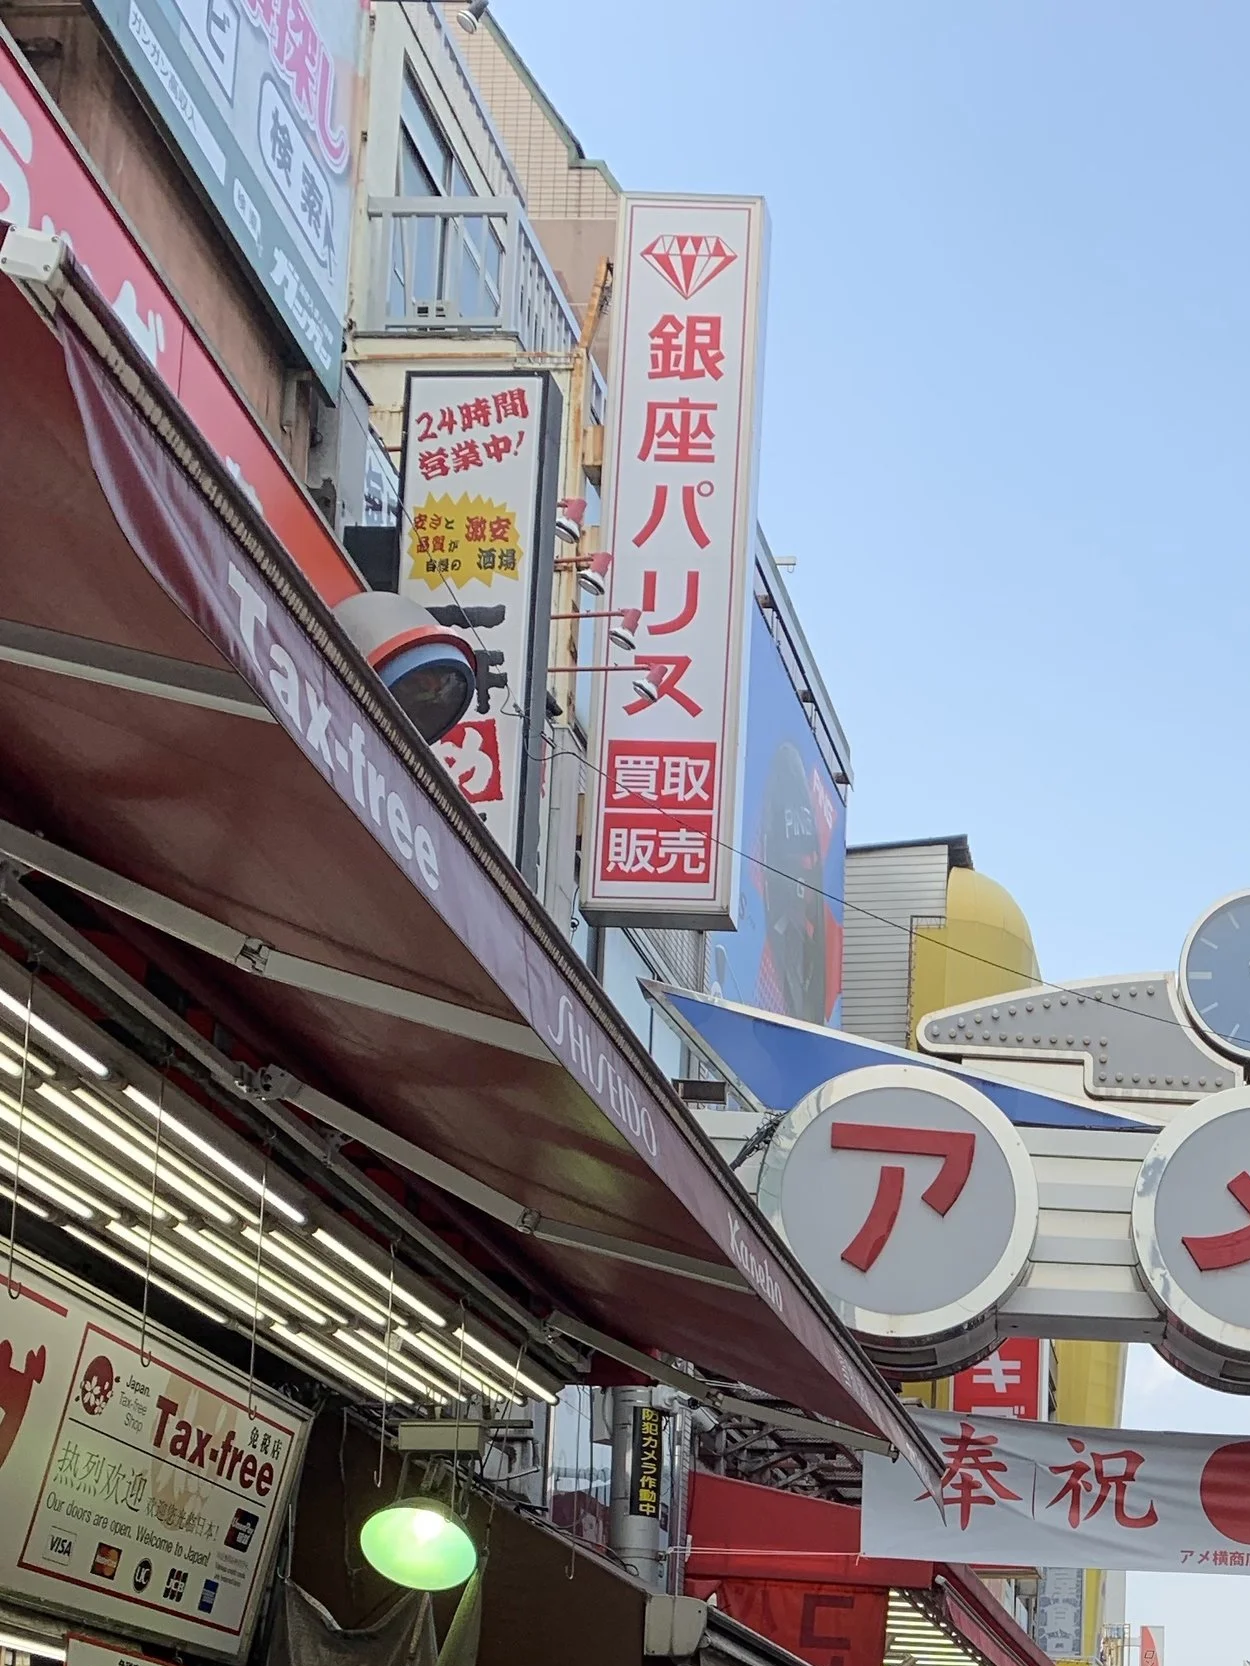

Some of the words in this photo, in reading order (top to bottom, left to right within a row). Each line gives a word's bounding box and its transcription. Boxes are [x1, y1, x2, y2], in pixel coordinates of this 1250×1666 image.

[270, 105, 325, 239] 検索
[415, 388, 530, 442] 24時間
[412, 513, 455, 530] 安さと
[465, 515, 512, 543] 激安
[622, 313, 726, 718] 銀座パリス
[415, 535, 459, 554] 品質が
[477, 547, 516, 571] 酒場
[222, 558, 441, 894] Tax-free
[611, 755, 711, 802] 買取
[605, 827, 707, 875] 販売
[547, 994, 660, 1158] SHISEIDO
[727, 1210, 785, 1314] Kanebo
[118, 1390, 148, 1417] Tax-free
[123, 1411, 144, 1434] Shop
[152, 1394, 275, 1498] Tax-free
[247, 1426, 283, 1460] 免税店
[638, 1407, 659, 1515] 防犯カメラ作動中
[52, 1440, 149, 1513] 热烈欢迎
[914, 1421, 1159, 1532] 奉祝
[46, 1491, 66, 1514] Our
[66, 1500, 92, 1524] doors
[92, 1512, 108, 1530] are
[135, 1524, 174, 1554] Welcome
[173, 1542, 184, 1558] to
[49, 1534, 73, 1558] VISA
[166, 1578, 185, 1593] JCB
